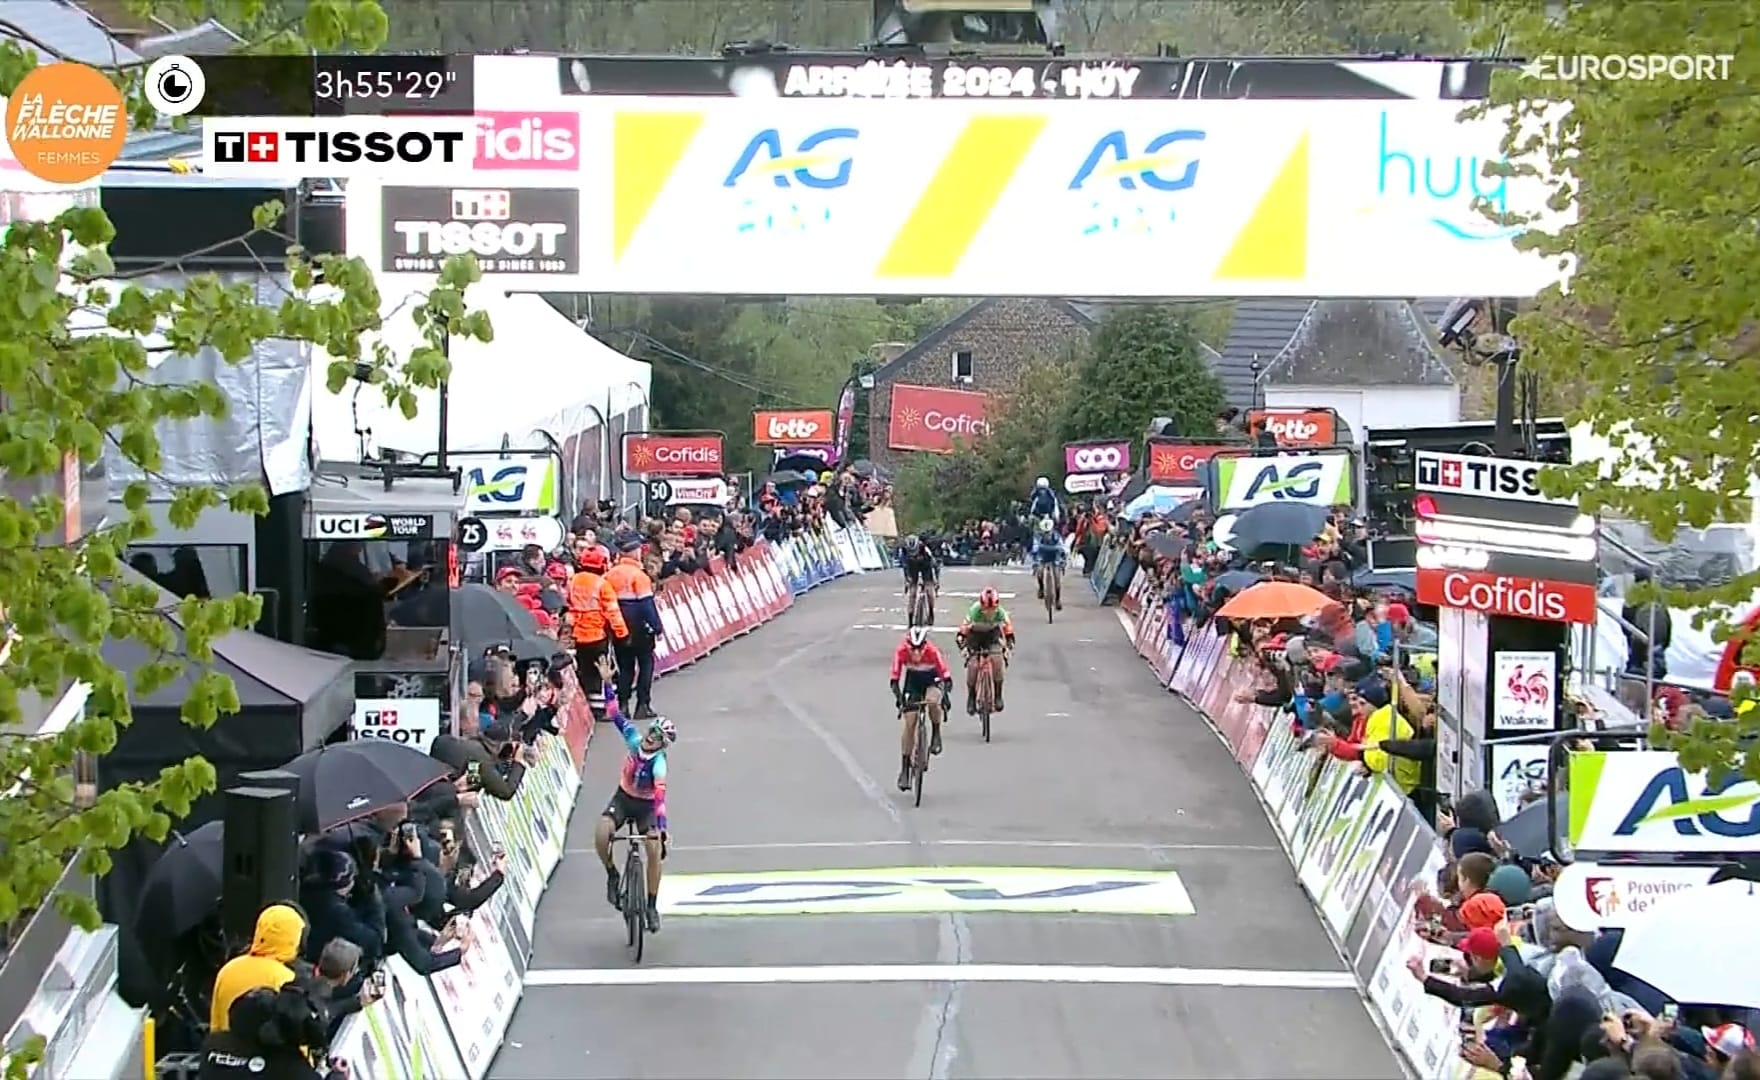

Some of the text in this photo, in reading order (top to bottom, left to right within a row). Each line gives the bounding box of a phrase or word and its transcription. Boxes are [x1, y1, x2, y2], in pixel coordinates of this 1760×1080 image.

[943, 66, 1035, 96] 2024
[722, 127, 860, 189] AG
[1067, 129, 1206, 191] AG
[394, 221, 567, 256] TISSOT
[655, 447, 718, 462] Cofidis
[651, 482, 668, 500] 50
[1243, 462, 1323, 501] AG
[1467, 462, 1543, 497] TISS
[319, 518, 427, 534] UCI WORLD
[392, 526, 418, 535] TOUR
[462, 524, 480, 544] 25
[1443, 572, 1566, 619] Cofidis
[354, 729, 425, 744] ISSOT
[1628, 897, 1648, 913] de
